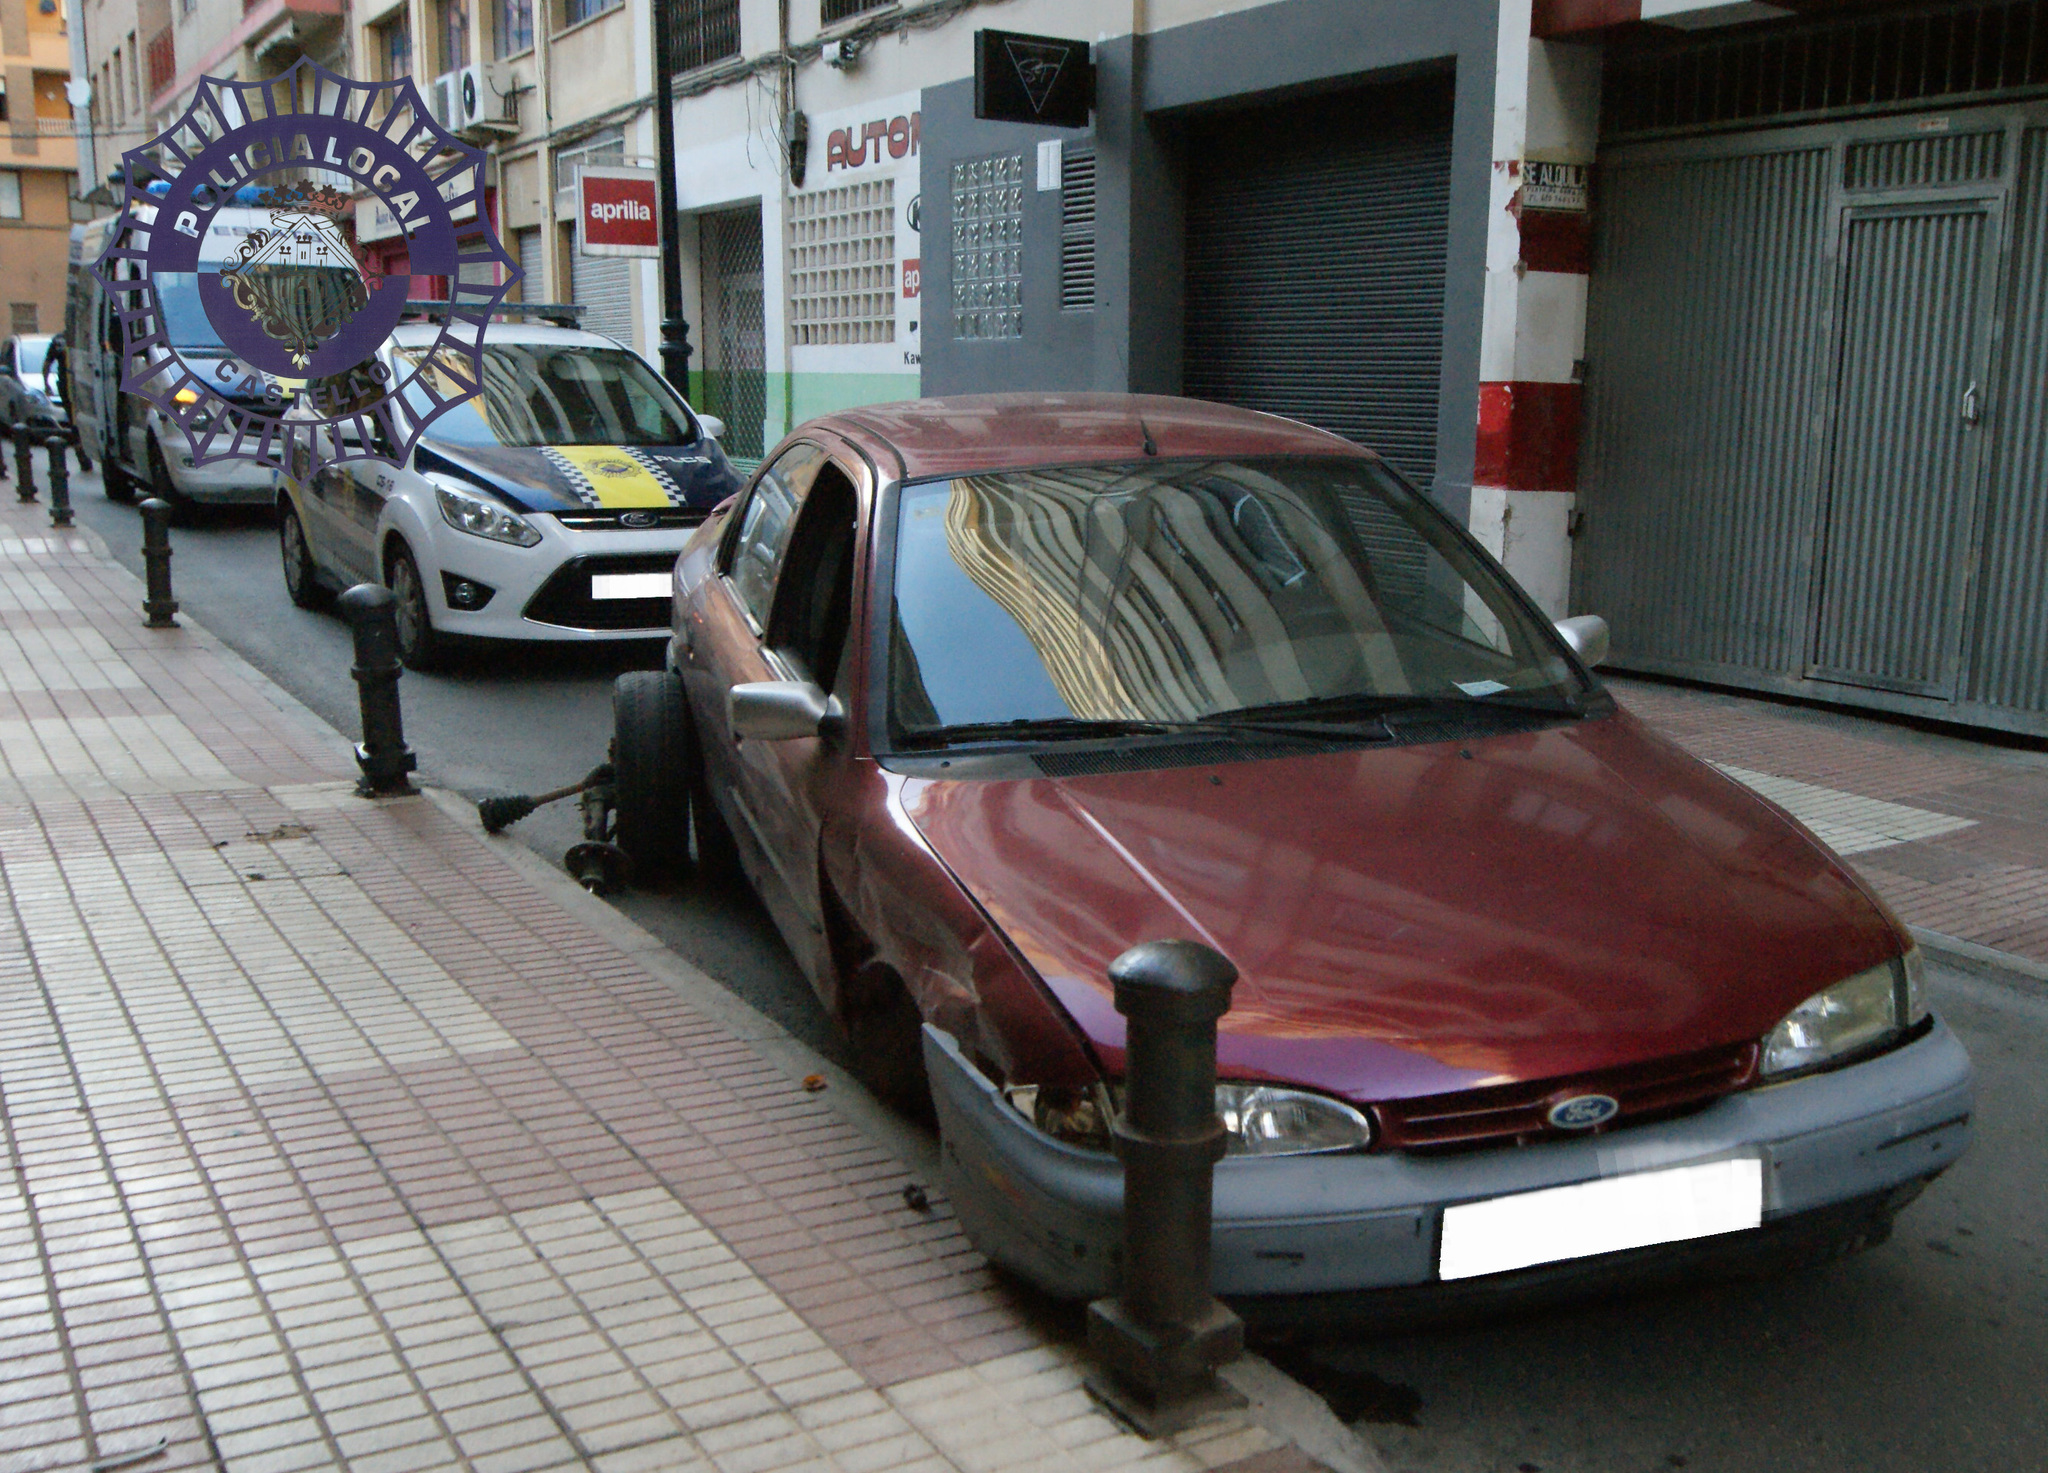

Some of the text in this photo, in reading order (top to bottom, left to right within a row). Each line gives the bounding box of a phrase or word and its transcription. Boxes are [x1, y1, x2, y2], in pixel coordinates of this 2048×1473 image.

[1522, 162, 1588, 189] SE ALQUILA
[591, 199, 651, 223] aprilia
